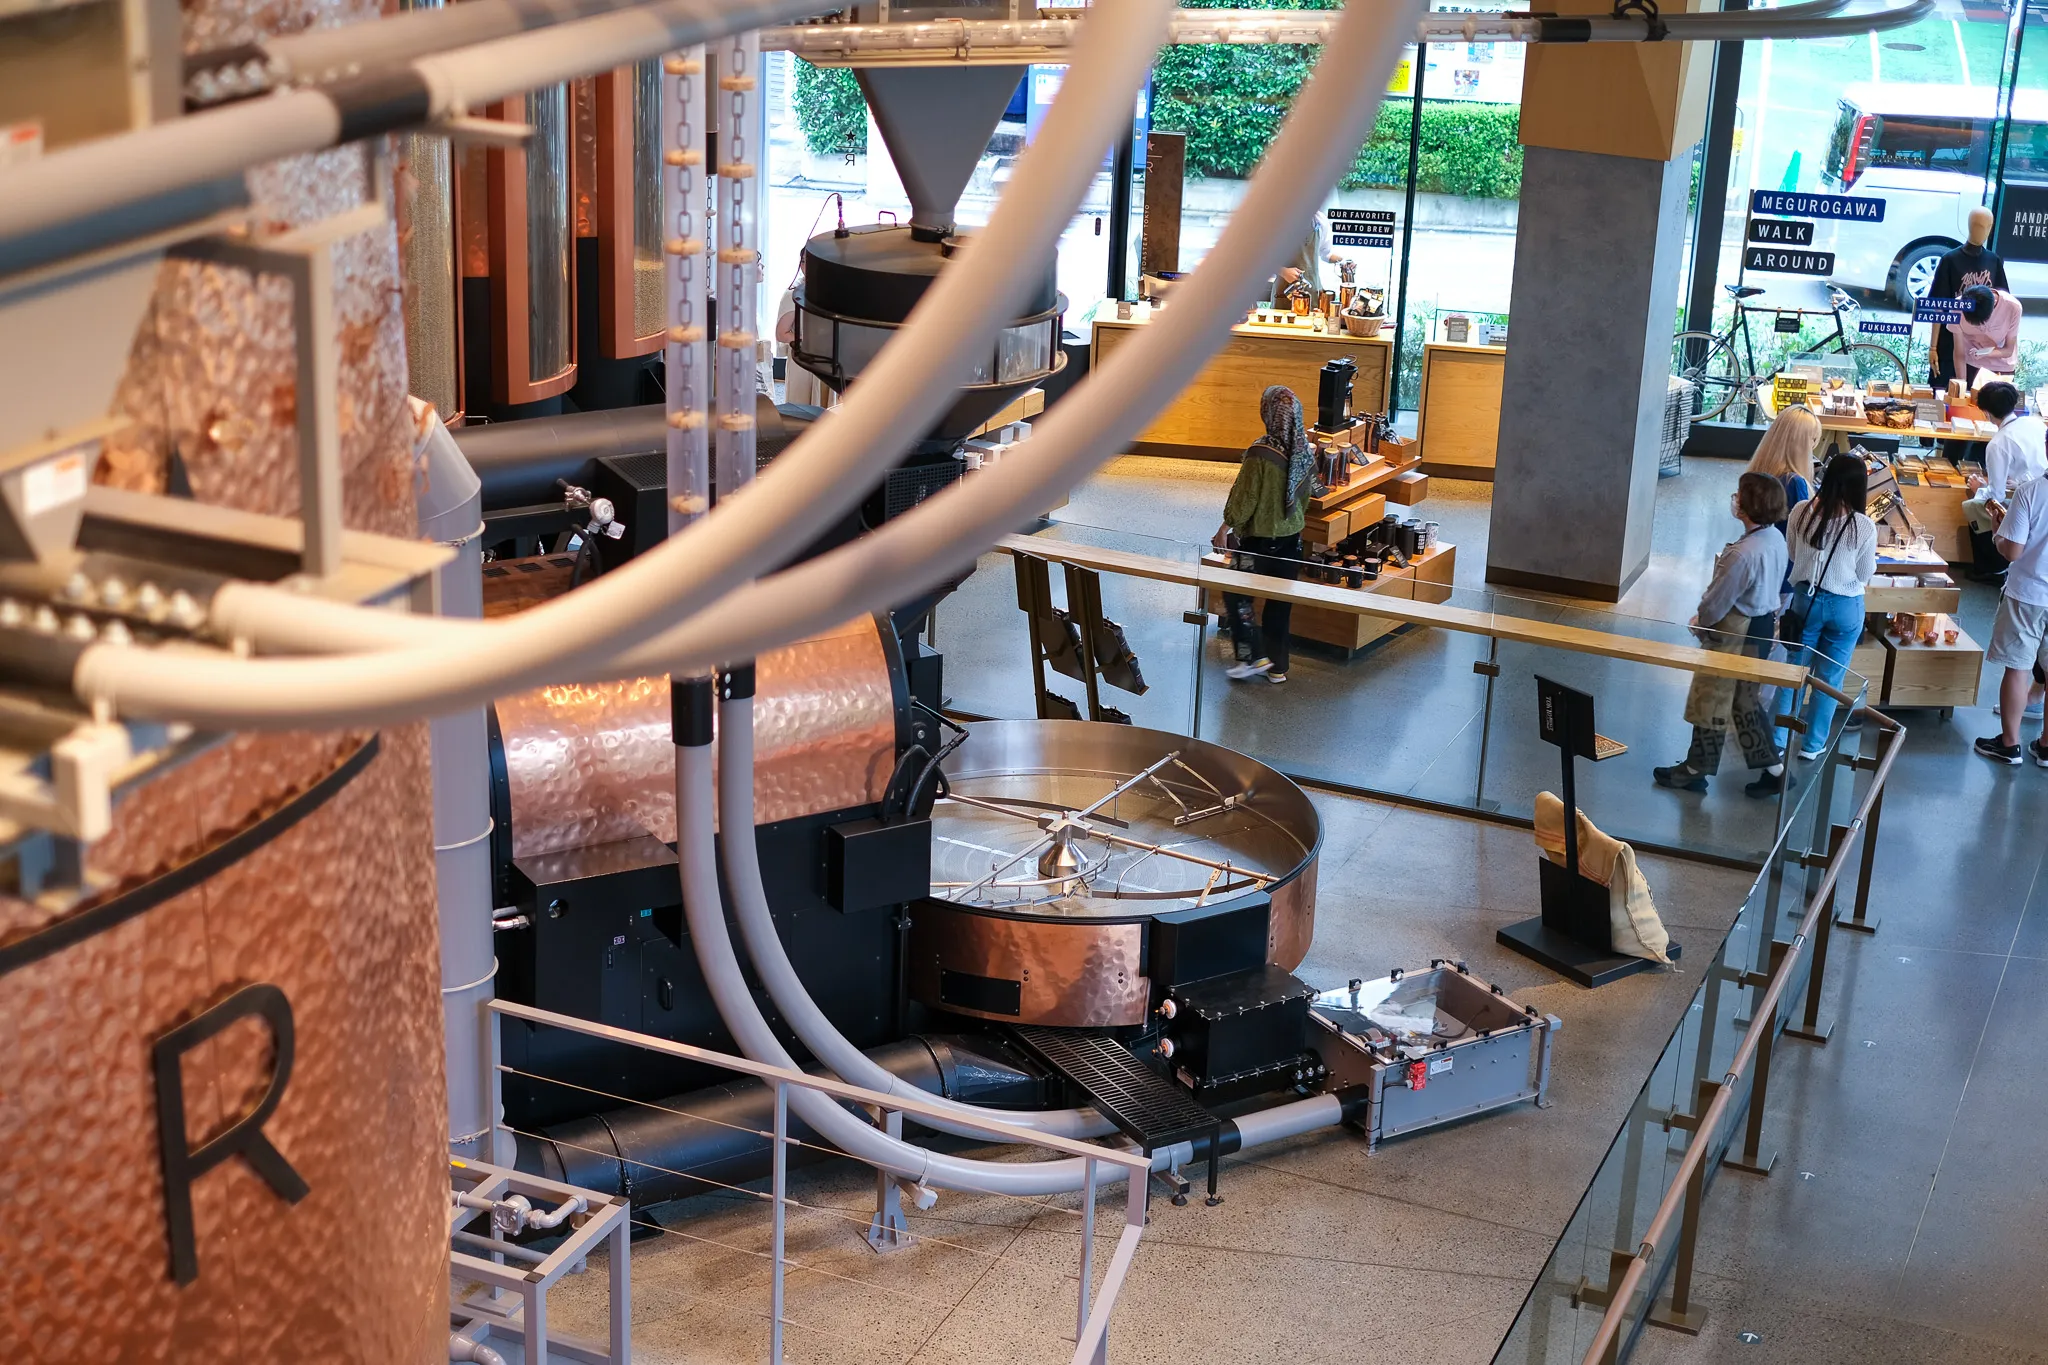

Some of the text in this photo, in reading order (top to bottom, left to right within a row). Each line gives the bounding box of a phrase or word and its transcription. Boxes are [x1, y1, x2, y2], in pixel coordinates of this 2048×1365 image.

[1761, 195, 1878, 217] MEGUROGAWA
[1350, 211, 1391, 220] FAVORITE
[1335, 223, 1352, 231] WAY
[1366, 225, 1390, 233] BREW
[1758, 224, 1806, 240] WALK
[2012, 225, 2048, 238] AT THE
[1357, 238, 1389, 246] COFFEE
[1753, 253, 1828, 270] AROUND
[1919, 299, 1972, 309] TRAVELER'S
[1917, 313, 1958, 322] FACTORY
[1862, 323, 1908, 333] FUKUSAYA
[154, 982, 311, 1288] R
